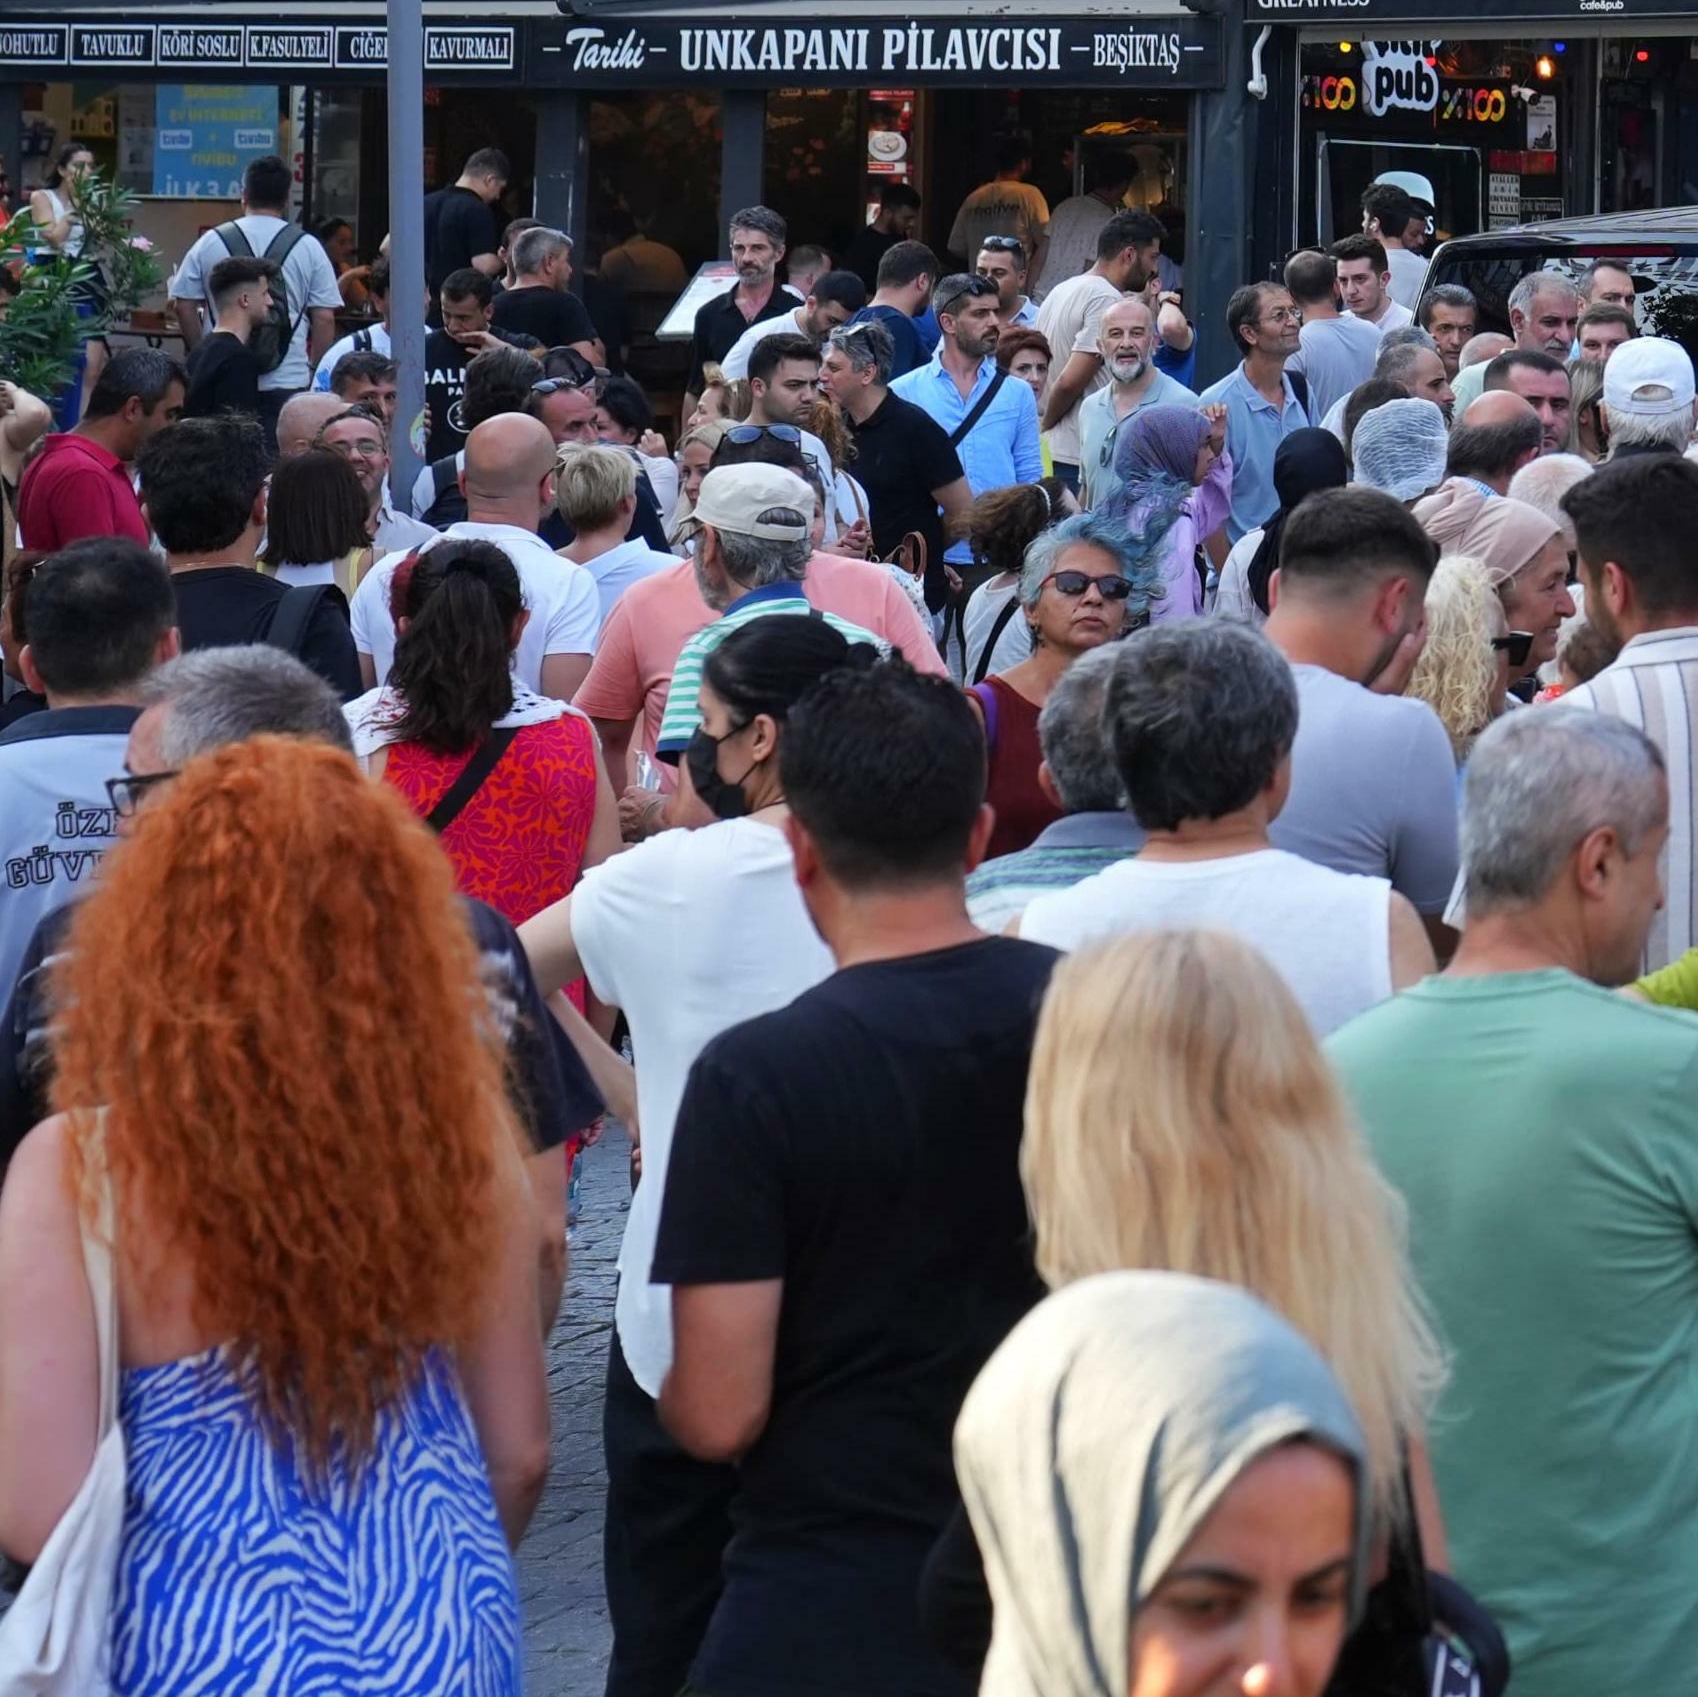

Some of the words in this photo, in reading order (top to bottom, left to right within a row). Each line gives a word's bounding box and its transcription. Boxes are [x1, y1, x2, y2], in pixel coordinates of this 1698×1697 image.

[81, 33, 145, 56] TAVUKLU
[196, 34, 240, 57] SOSLU
[250, 31, 329, 59] K.FASULYELİ
[350, 31, 388, 59] CİĞE
[429, 36, 509, 59] KAVURMALI
[565, 27, 647, 70] Tarihi
[680, 29, 869, 71] UNKAPANI
[882, 21, 1062, 71] PİLAVCISI
[1093, 24, 1180, 75] BEŞİKTAŞ
[1375, 60, 1434, 109] pub
